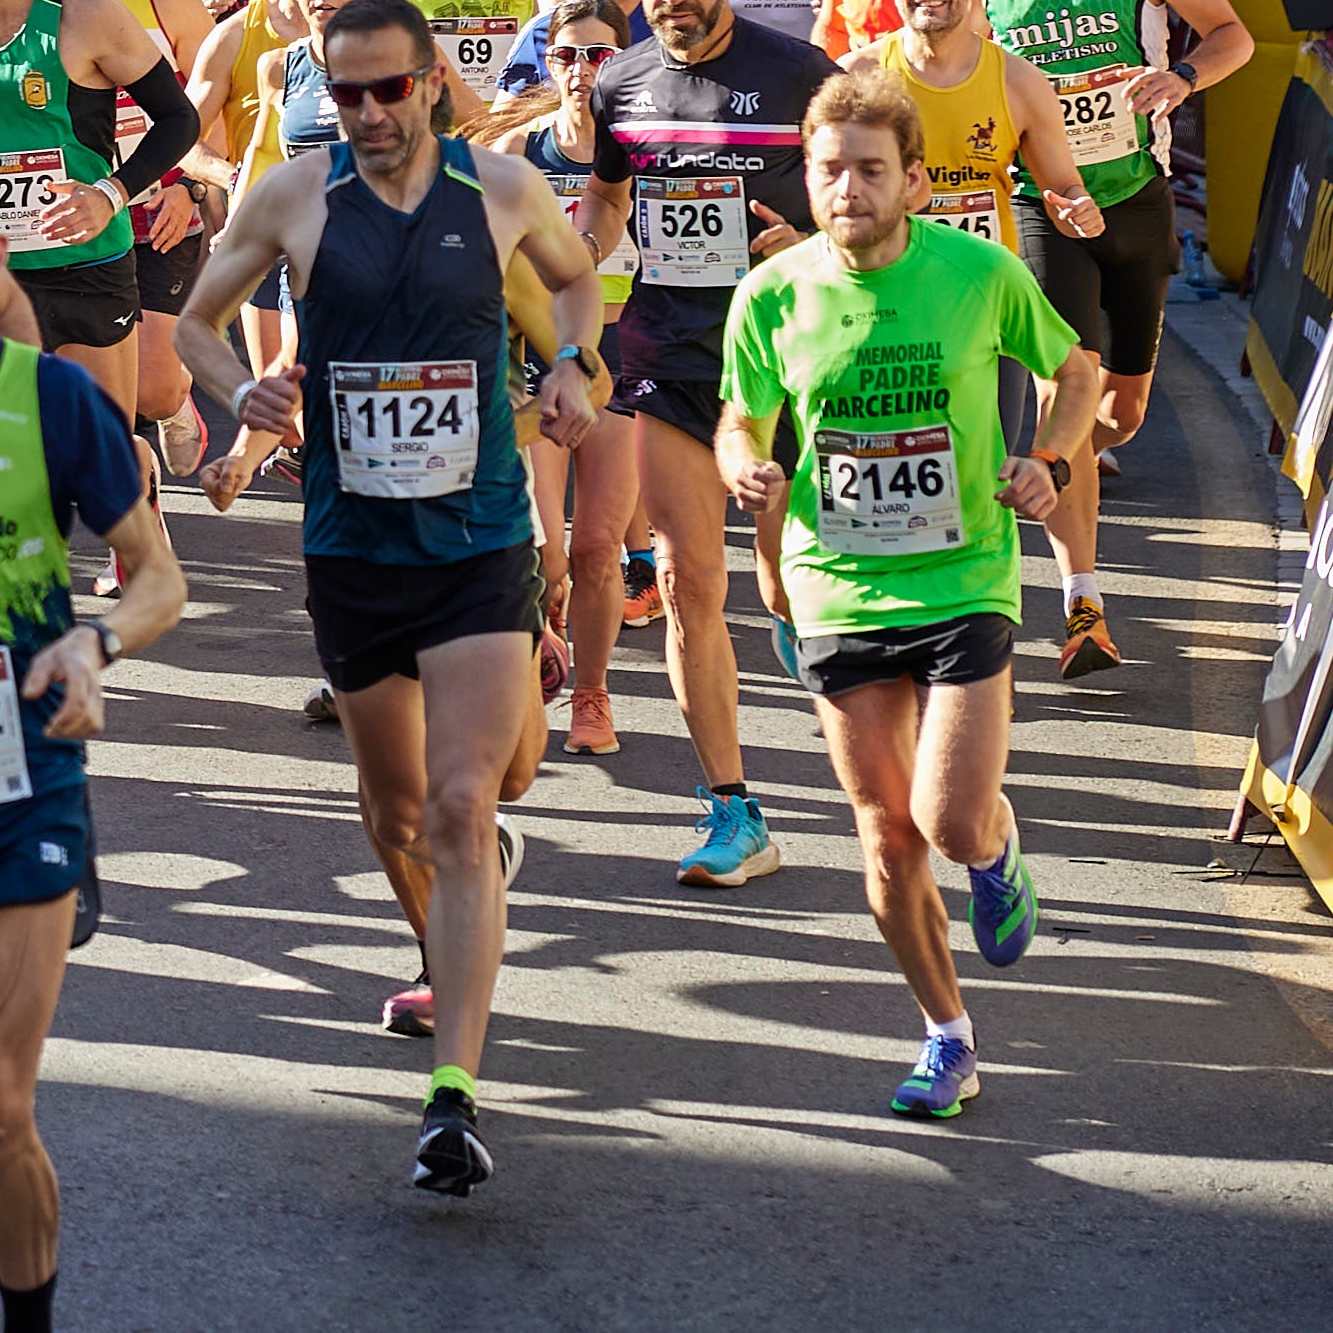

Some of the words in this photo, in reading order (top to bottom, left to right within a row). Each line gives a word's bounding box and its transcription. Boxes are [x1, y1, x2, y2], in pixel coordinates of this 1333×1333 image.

[1007, 9, 1119, 48] mijas
[459, 39, 492, 64] 69
[1024, 41, 1118, 64] TLETISMO
[1083, 122, 1112, 134] CARLOS
[17, 209, 41, 219] DANIE
[661, 203, 723, 238] 526
[933, 216, 991, 240] 45
[677, 241, 706, 250] VICTOR
[856, 342, 943, 367] MEMORIAL
[859, 363, 941, 392] PADRE
[358, 394, 463, 438] 1124
[819, 388, 950, 420] MARCELINO
[391, 442, 429, 453] SERGIO
[838, 459, 944, 501] 2146
